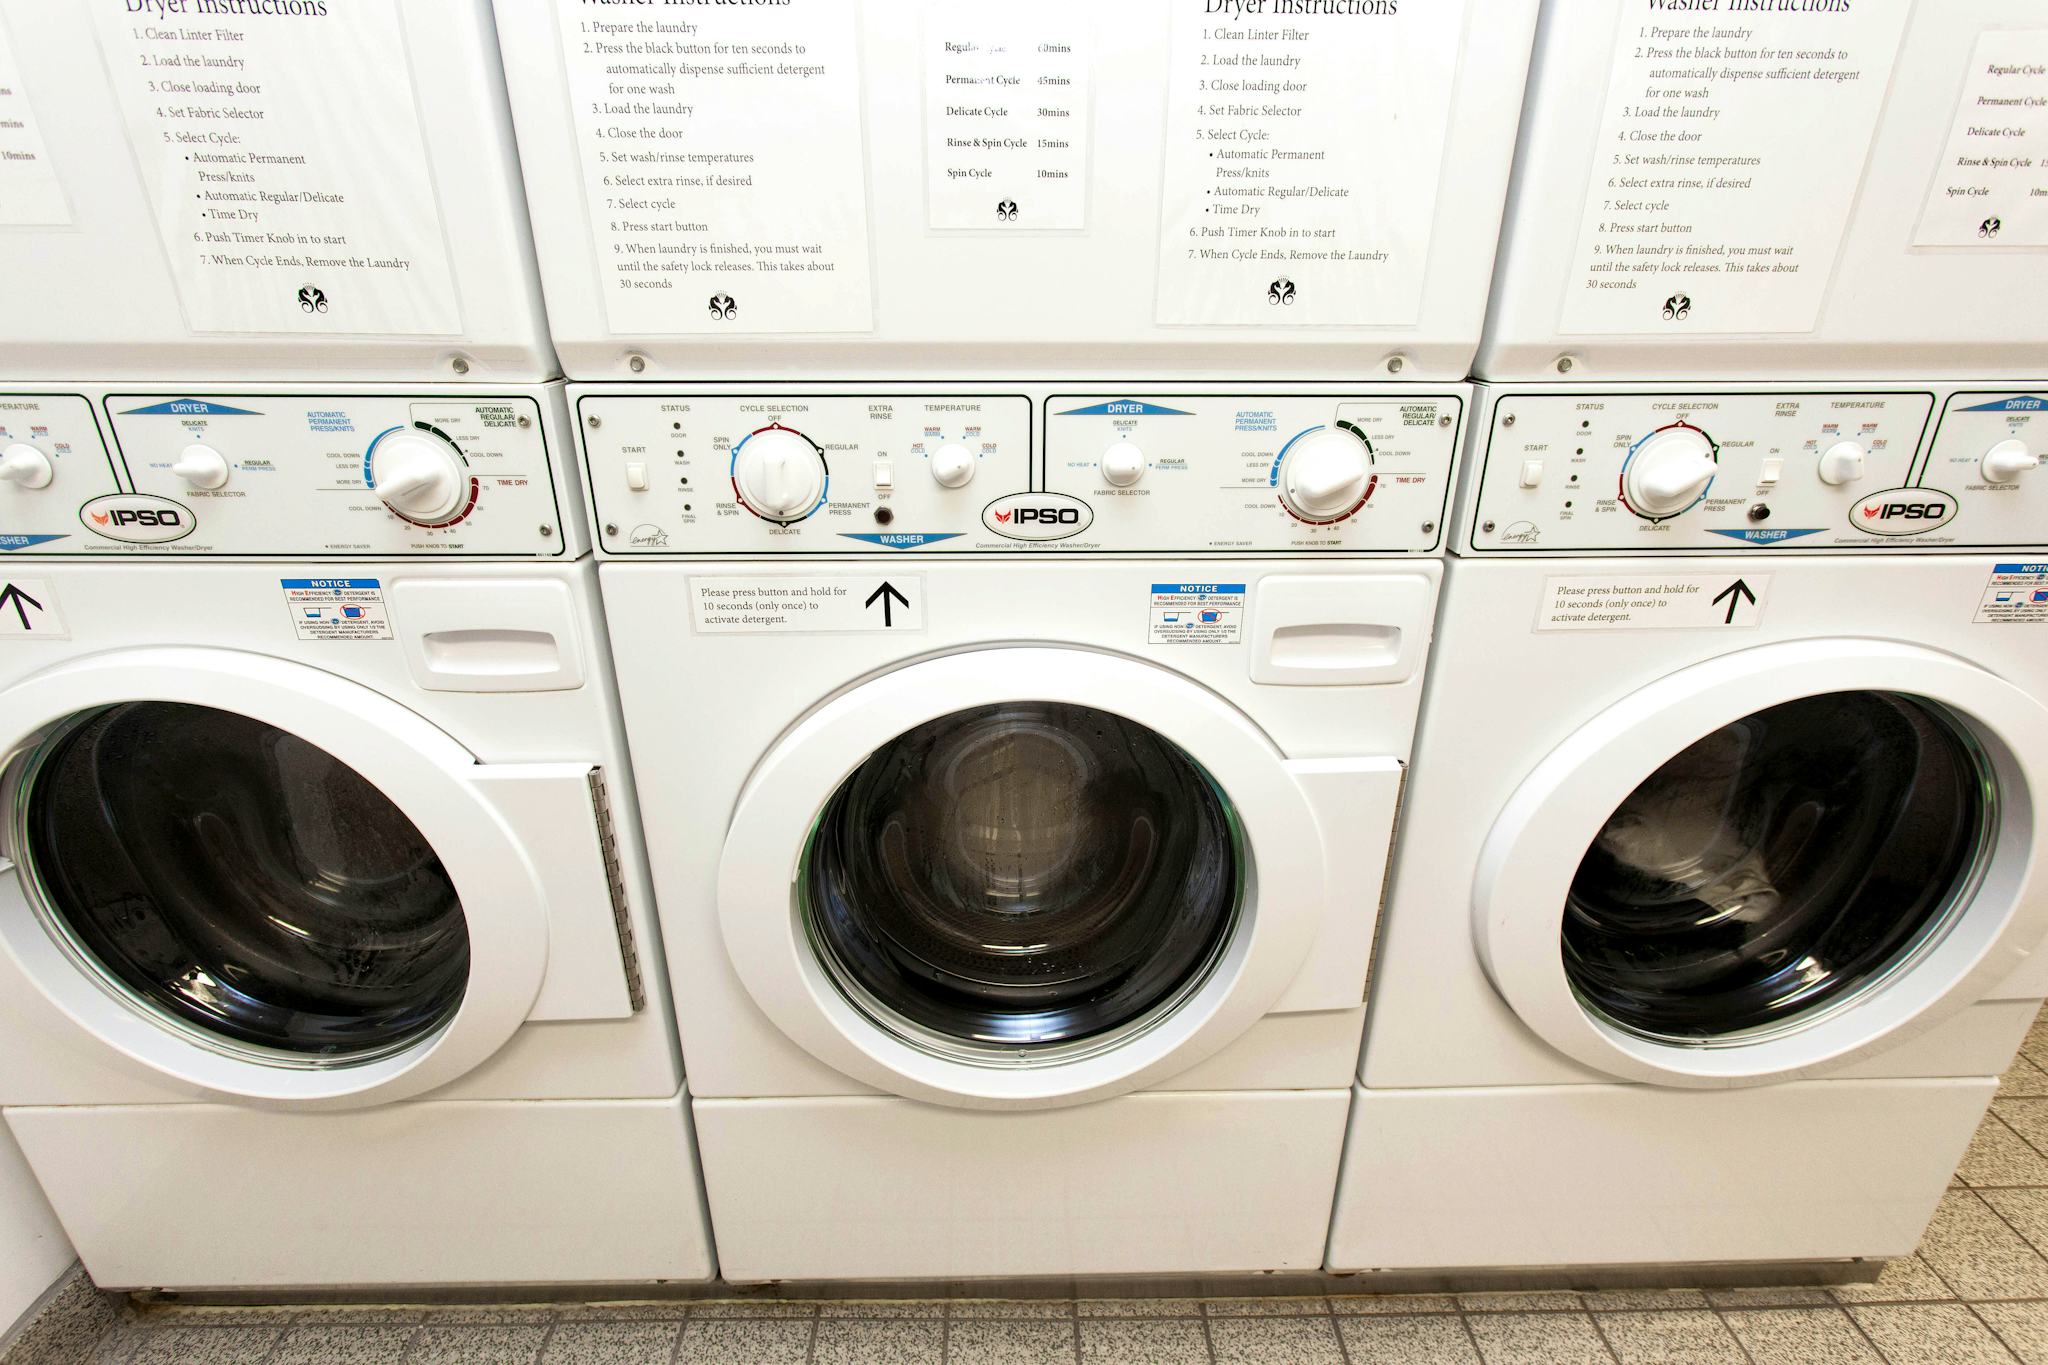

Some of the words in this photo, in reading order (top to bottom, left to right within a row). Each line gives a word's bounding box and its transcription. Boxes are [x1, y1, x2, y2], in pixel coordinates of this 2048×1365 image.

[1205, 0, 1267, 21] Dryer
[1273, 0, 1397, 15] Instructions
[133, 28, 143, 39] 1.
[145, 27, 178, 40] Clean
[178, 28, 212, 41] Linter
[215, 28, 244, 41] Filter
[581, 21, 590, 33] 1.
[592, 21, 634, 37] Prepare
[636, 20, 654, 33] the
[656, 21, 698, 36] laundry
[140, 54, 151, 66] 2.
[152, 54, 182, 67] Load
[183, 54, 201, 67] the
[201, 55, 244, 71] laundry
[606, 62, 676, 77] automatically
[679, 62, 724, 77] dispense
[727, 62, 774, 75] sufficient
[776, 63, 825, 77] detergent
[148, 81, 159, 92] 3.
[161, 80, 191, 93] Close
[192, 81, 235, 97] loading
[235, 81, 261, 94] door
[1645, 87, 1661, 98] for
[1662, 90, 1682, 98] one
[1684, 87, 1709, 98] wash
[156, 107, 167, 118] 4.
[168, 106, 186, 118] Set
[187, 106, 221, 118] Fabric
[222, 107, 264, 119] Selector
[592, 103, 602, 114] 3.
[604, 102, 631, 114] Load
[633, 102, 650, 114] the
[652, 102, 693, 117] laundry
[946, 106, 982, 116] Delicate
[984, 107, 1008, 118] Cycle
[1037, 108, 1070, 117] 30mins
[163, 132, 174, 143] 5.
[175, 131, 207, 143] Select
[208, 132, 241, 145] Cycle:
[596, 128, 605, 138] 4.
[607, 127, 637, 138] Close
[639, 127, 656, 139] the
[658, 127, 683, 139] door
[1967, 126, 2001, 136] Delicate
[2002, 127, 2026, 139] Cycle
[947, 138, 972, 147] Rinse
[973, 138, 981, 147] &
[982, 138, 1002, 150] Spin
[1003, 138, 1027, 150] Cycle
[1038, 139, 1069, 148] 15mins
[600, 151, 609, 162] 5.
[611, 151, 628, 162] Set
[630, 151, 685, 162] wash/rinse
[688, 153, 754, 166] temperatures
[1957, 157, 1981, 166] Rinse
[1981, 157, 1990, 166] &
[1989, 157, 2009, 169] Spin
[2009, 158, 2032, 169] Cycle
[198, 171, 255, 182] Press/knits
[947, 168, 967, 180] Spin
[968, 168, 992, 179] Cycle
[1037, 169, 1068, 178] 10mins
[603, 176, 613, 186] 6.
[615, 174, 645, 186] Select
[647, 177, 673, 186] extra
[676, 175, 704, 187] rinse,
[706, 174, 714, 186] if
[716, 175, 752, 186] desired
[1214, 186, 1265, 196] Automatic
[1268, 186, 1349, 199] Regular/Delicate
[1946, 186, 1966, 198] Spin
[1967, 187, 1990, 198] Cycle
[606, 198, 617, 209] 7.
[618, 198, 648, 209] Select
[650, 198, 676, 212] cycle
[208, 208, 236, 219] Time
[238, 209, 258, 223] Dry
[610, 222, 620, 231] 8.
[622, 221, 649, 231] Press
[650, 223, 673, 231] start
[675, 221, 708, 232] button
[1598, 223, 1606, 232] 8.
[1610, 222, 1635, 233] Press
[1636, 224, 1659, 233] start
[1660, 222, 1692, 233] button
[1188, 249, 1196, 259] 7.
[1200, 249, 1229, 259] When
[1231, 249, 1258, 262] Cycle
[1260, 249, 1287, 260] Ends,
[1289, 250, 1328, 260] Remove
[1330, 249, 1346, 260] the
[1348, 250, 1389, 263] Laundry
[170, 404, 208, 413] DRYER
[924, 404, 981, 412] TEMPERATURE
[1108, 404, 1143, 413] DRYER
[2005, 400, 2041, 409] DRYER
[1014, 508, 1079, 524] IPSO
[1880, 503, 1946, 519] IPSO
[110, 510, 180, 526] IPSO
[880, 535, 924, 543] WASHER
[1745, 530, 1787, 540] WASHER
[701, 588, 730, 597] Please
[732, 589, 756, 599] press
[757, 587, 789, 596] button
[791, 587, 808, 596] and
[810, 587, 831, 596] hold
[833, 587, 847, 596] for
[704, 602, 714, 610] 10
[716, 601, 753, 610] seconds
[755, 601, 780, 612] (only
[781, 601, 807, 611] once)
[809, 602, 819, 610] to
[704, 615, 740, 624] activate
[741, 615, 787, 626] detergent.
